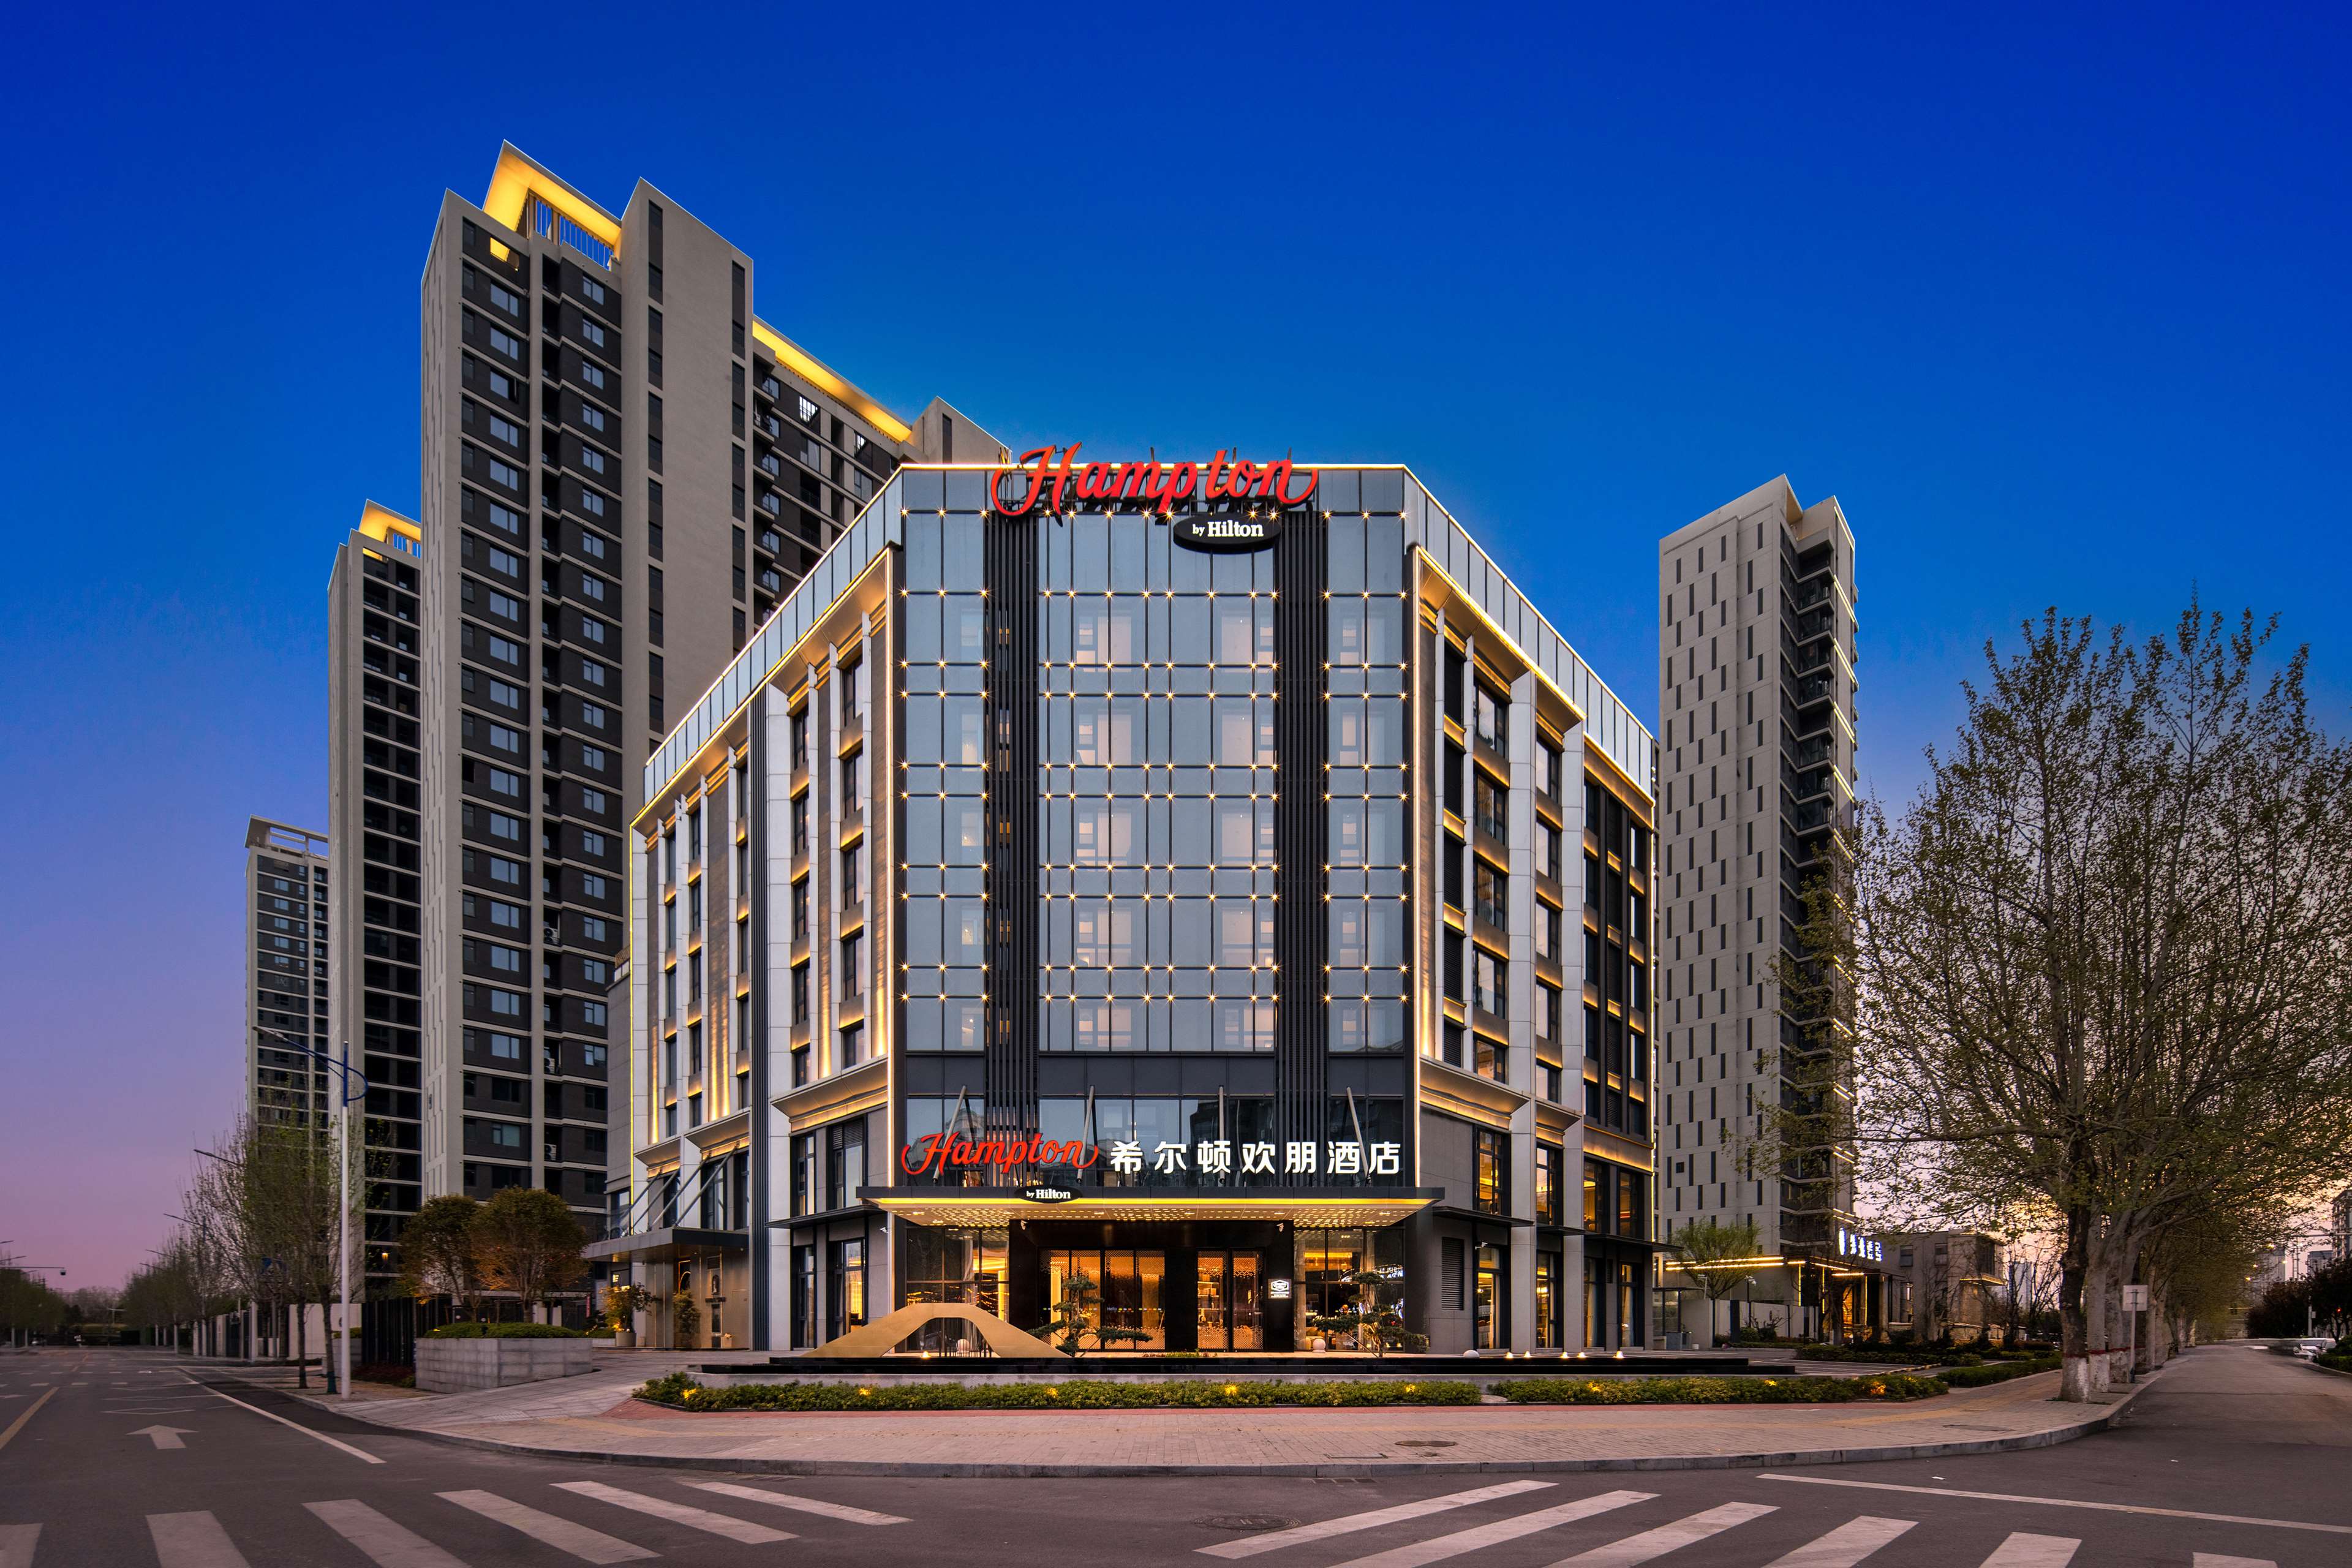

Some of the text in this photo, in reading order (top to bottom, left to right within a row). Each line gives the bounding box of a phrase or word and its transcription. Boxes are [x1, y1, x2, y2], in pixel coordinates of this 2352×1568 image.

[990, 441, 1319, 519] Hampton
[1192, 519, 1264, 537] by Hilton
[901, 1131, 1099, 1175] Hampton
[1110, 1140, 1401, 1175] 希尔顿欢朋酒店
[1026, 1188, 1071, 1199] by Hilton
